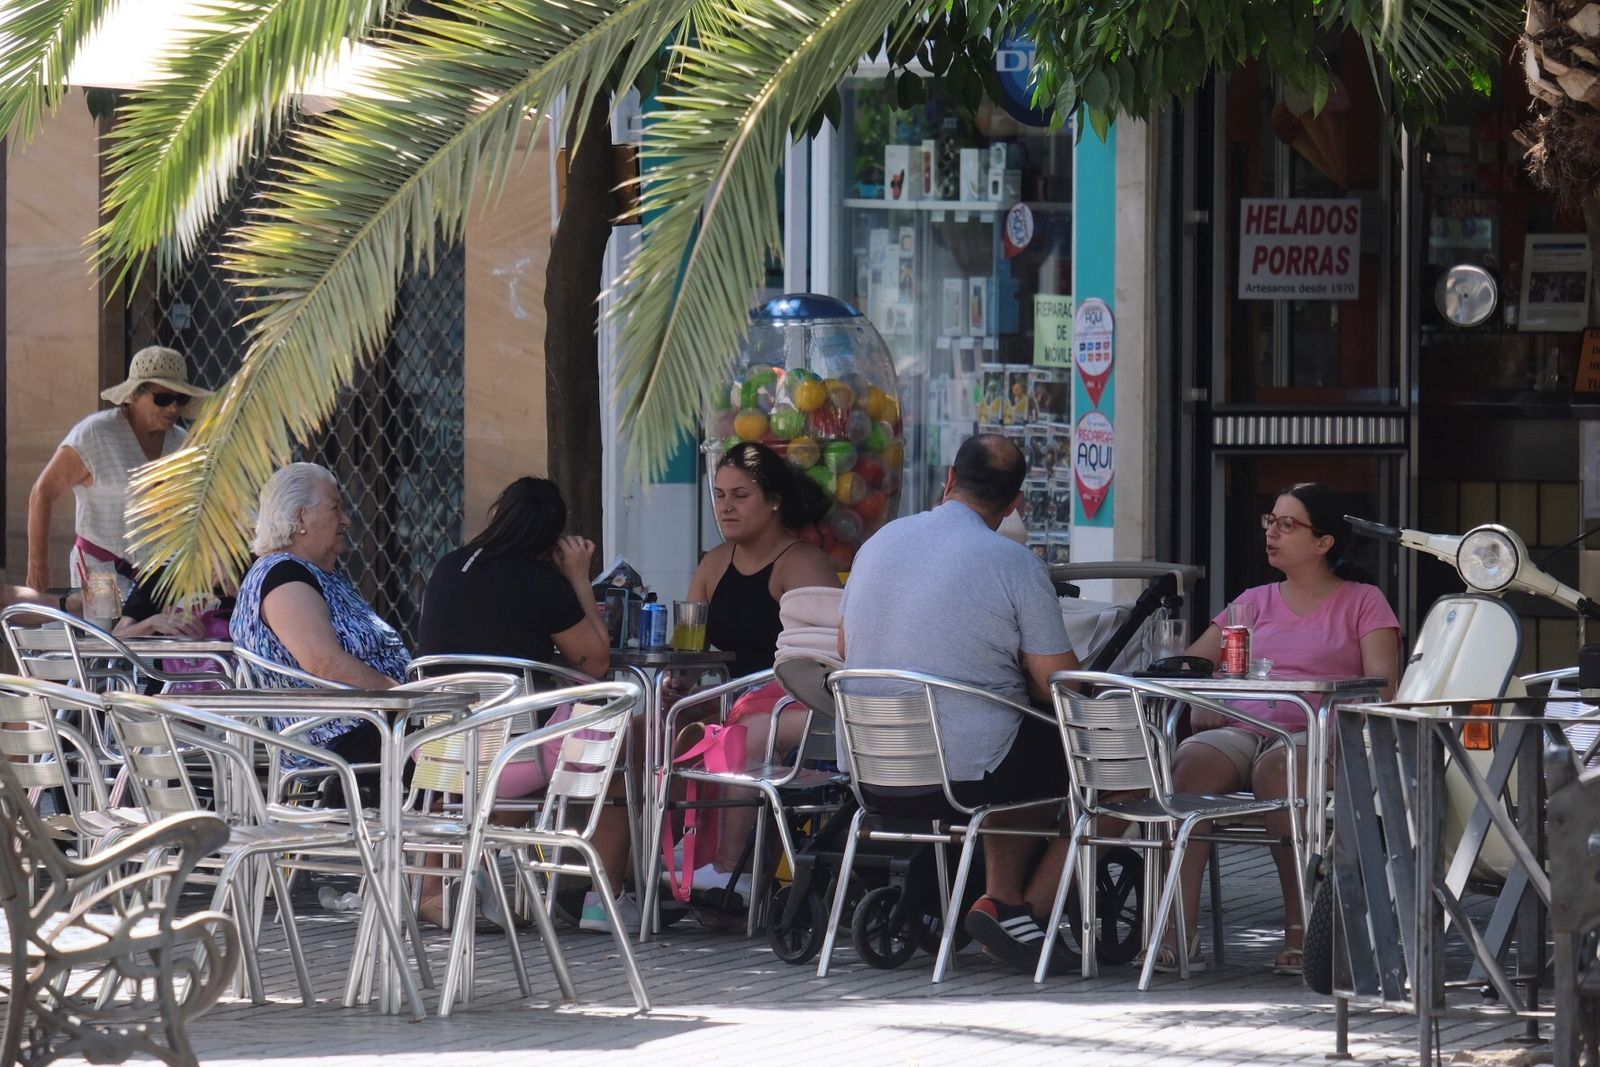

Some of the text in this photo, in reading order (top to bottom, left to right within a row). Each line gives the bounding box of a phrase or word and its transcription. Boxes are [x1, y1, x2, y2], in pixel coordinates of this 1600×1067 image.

[1245, 204, 1359, 235] HELADOS
[1252, 245, 1351, 276] PORRAS
[1245, 283, 1354, 293] Artesanos desde 1970
[1057, 324, 1067, 340] DE
[1077, 442, 1112, 471] AQUI
